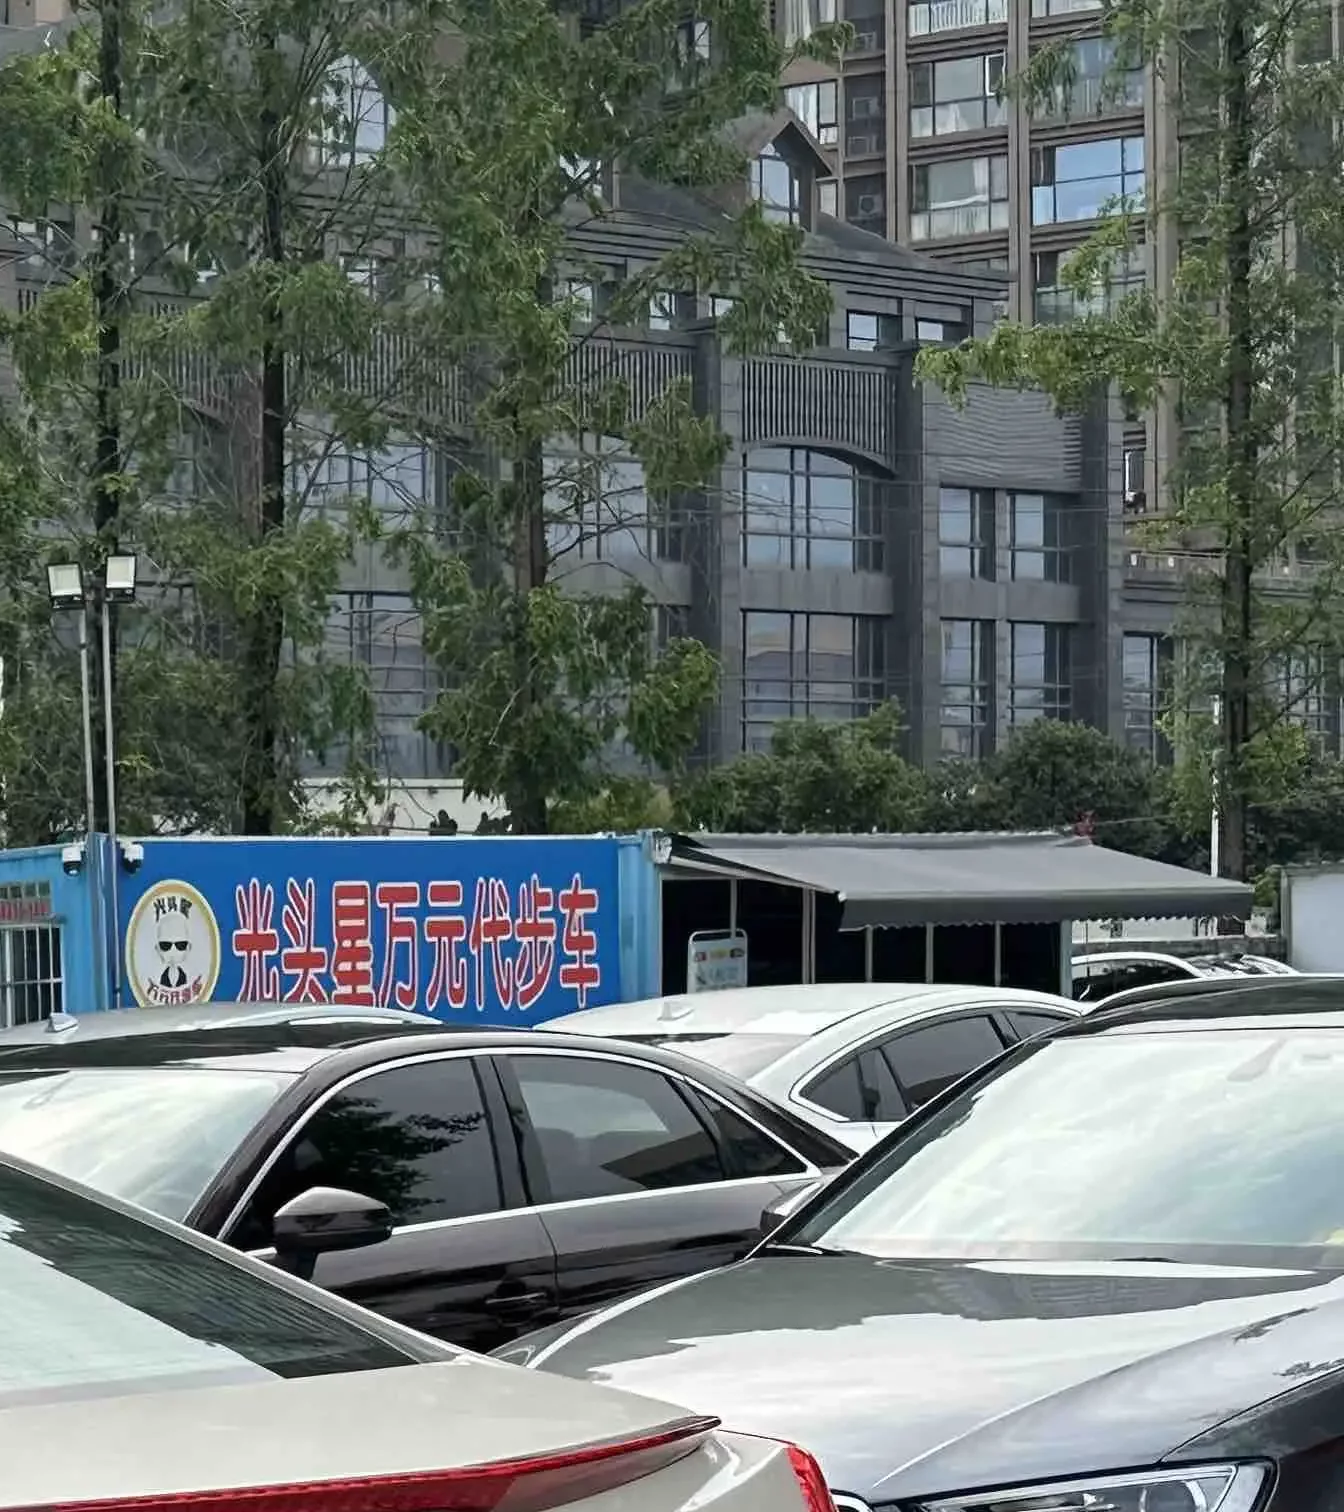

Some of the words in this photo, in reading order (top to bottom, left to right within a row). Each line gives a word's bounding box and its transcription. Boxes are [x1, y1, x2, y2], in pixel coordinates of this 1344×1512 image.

[232, 873, 601, 1012] 光头星万元代步车
